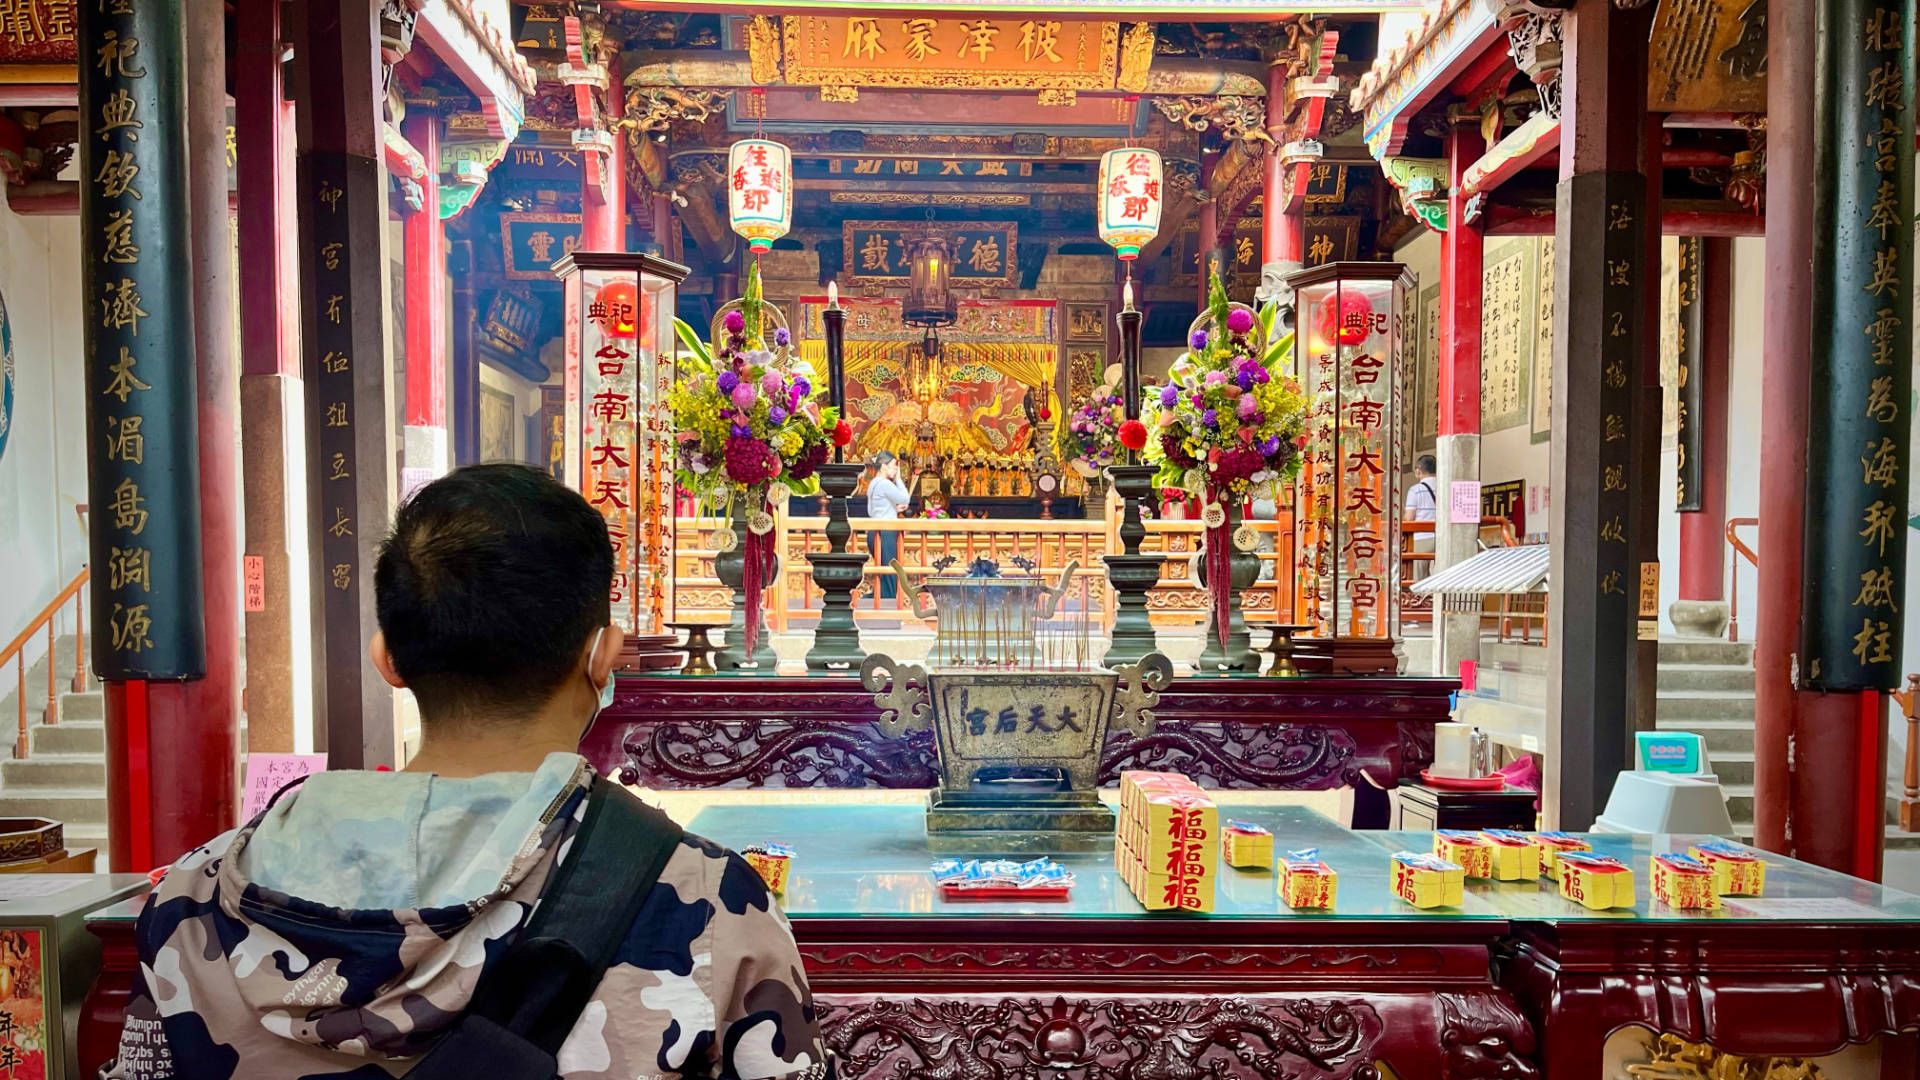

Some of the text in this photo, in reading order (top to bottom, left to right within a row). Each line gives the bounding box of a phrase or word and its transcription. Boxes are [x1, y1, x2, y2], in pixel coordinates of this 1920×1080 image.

[1343, 354, 1384, 607] 台南大天后宮
[1398, 862, 1416, 904] 福
[1563, 864, 1584, 902] 福
